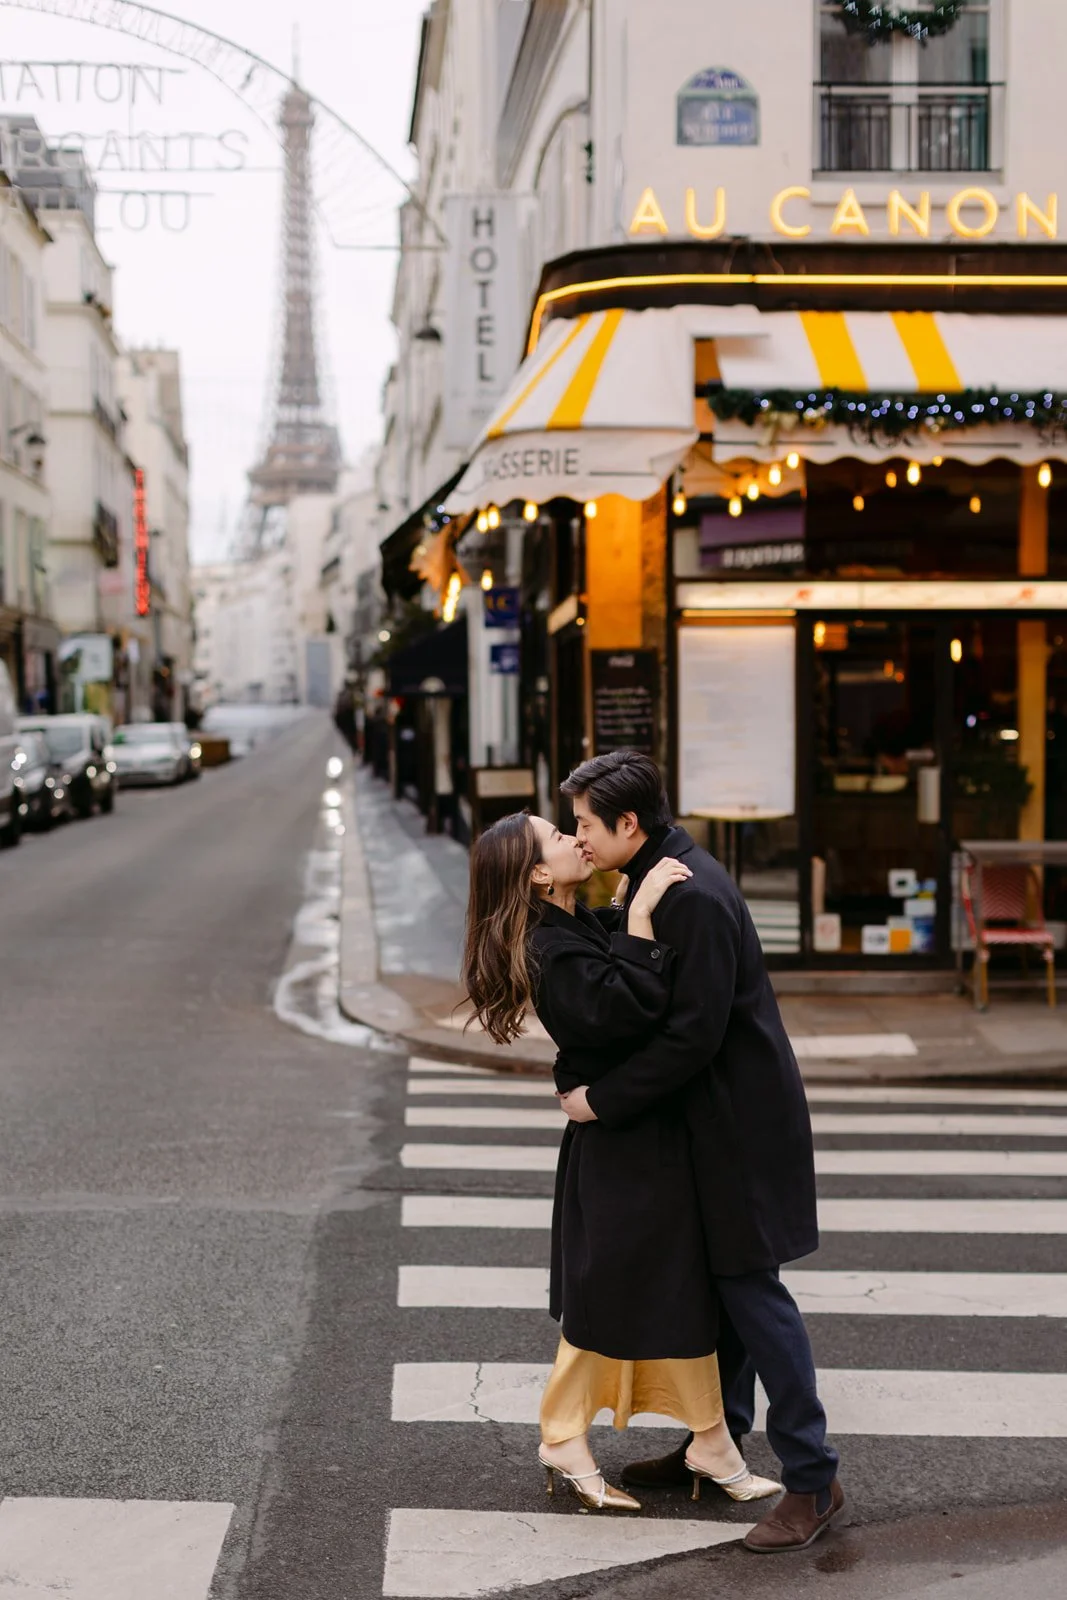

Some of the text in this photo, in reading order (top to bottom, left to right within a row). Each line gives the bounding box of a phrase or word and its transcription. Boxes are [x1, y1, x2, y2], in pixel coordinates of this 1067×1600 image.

[629, 186, 1059, 240] AU CANON
[469, 207, 498, 382] HOTEL
